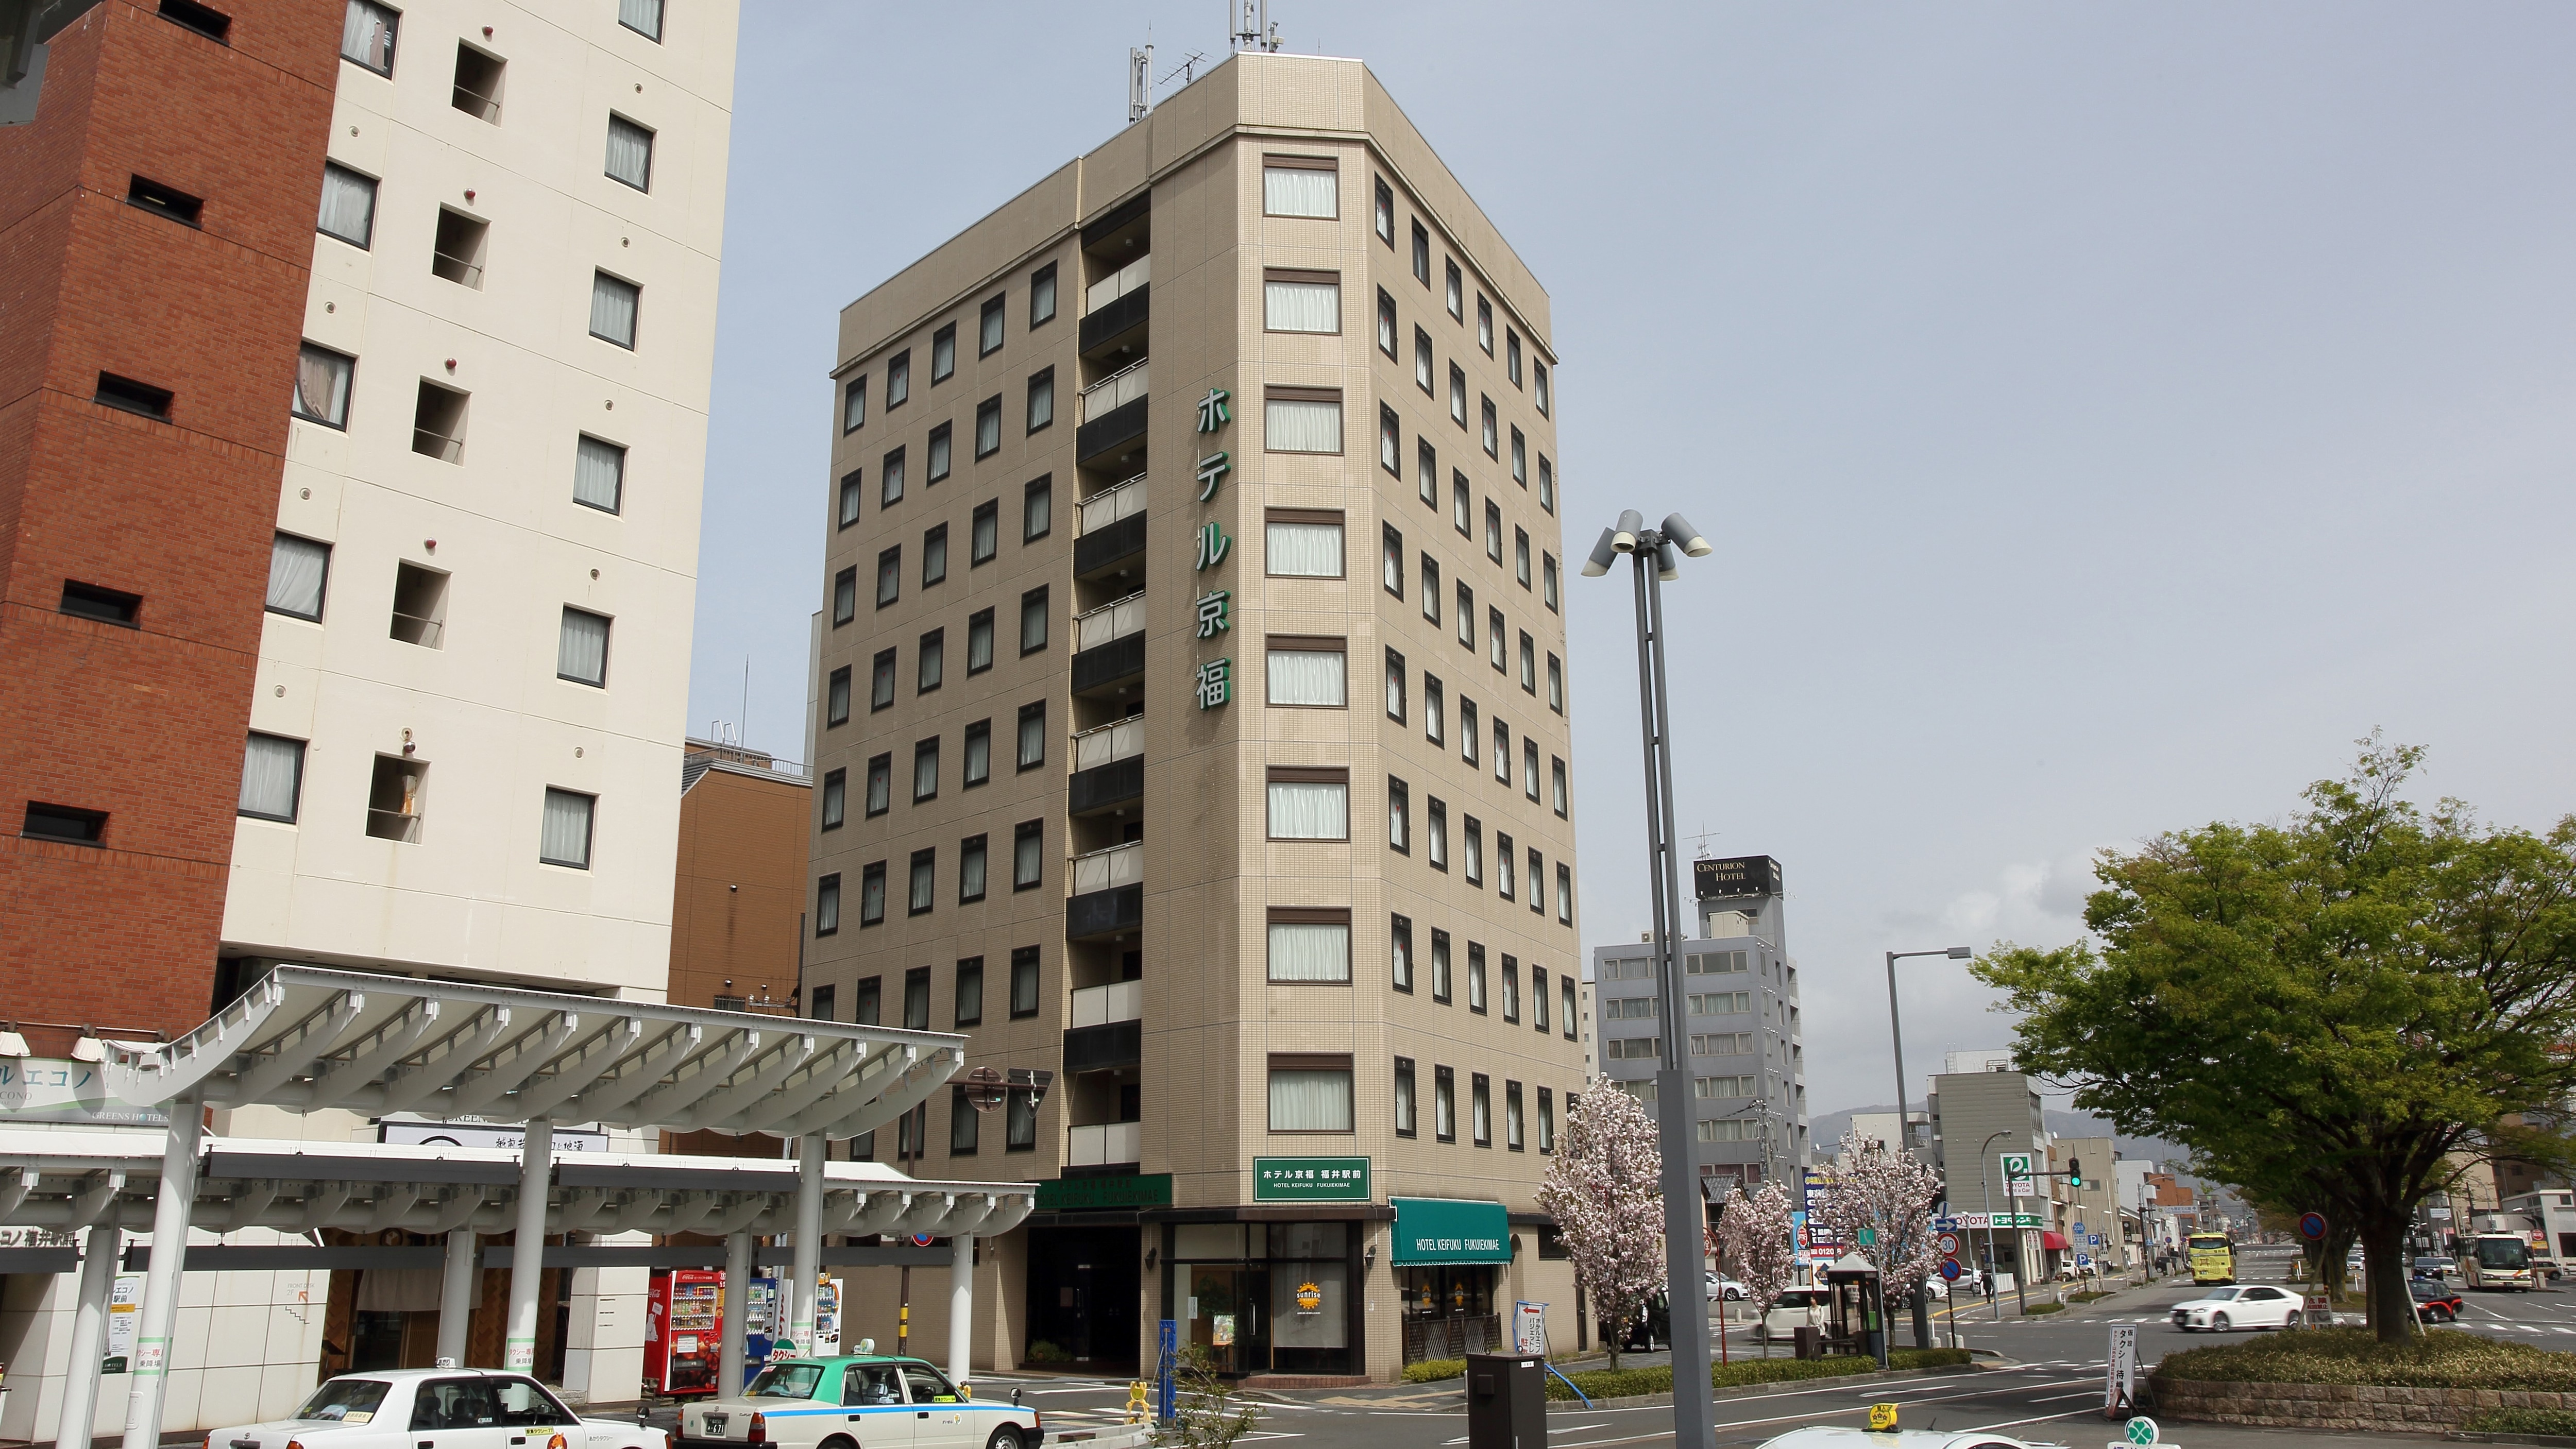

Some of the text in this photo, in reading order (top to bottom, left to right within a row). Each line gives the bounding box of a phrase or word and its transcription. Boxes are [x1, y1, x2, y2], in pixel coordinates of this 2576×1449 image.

[1196, 388, 1231, 710] ホテル京福
[1716, 873, 1746, 881] HOTEL
[92, 1112, 170, 1122] GREENS HOTELS
[1263, 1170, 1361, 1179] ホテル京福 福井駅前
[1061, 1191, 1094, 1205] KEIFUKU
[1104, 1189, 1158, 1204] FUKUIEKIMAE
[1956, 1217, 1989, 1225] OYOTA
[2090, 1235, 2097, 1244] P
[1416, 1239, 1500, 1251] HOTEL KEIFUKU FUKUIEKIMAE
[1942, 1239, 1955, 1251] 30
[2079, 1254, 2086, 1264] P
[773, 1350, 796, 1361] タクシー
